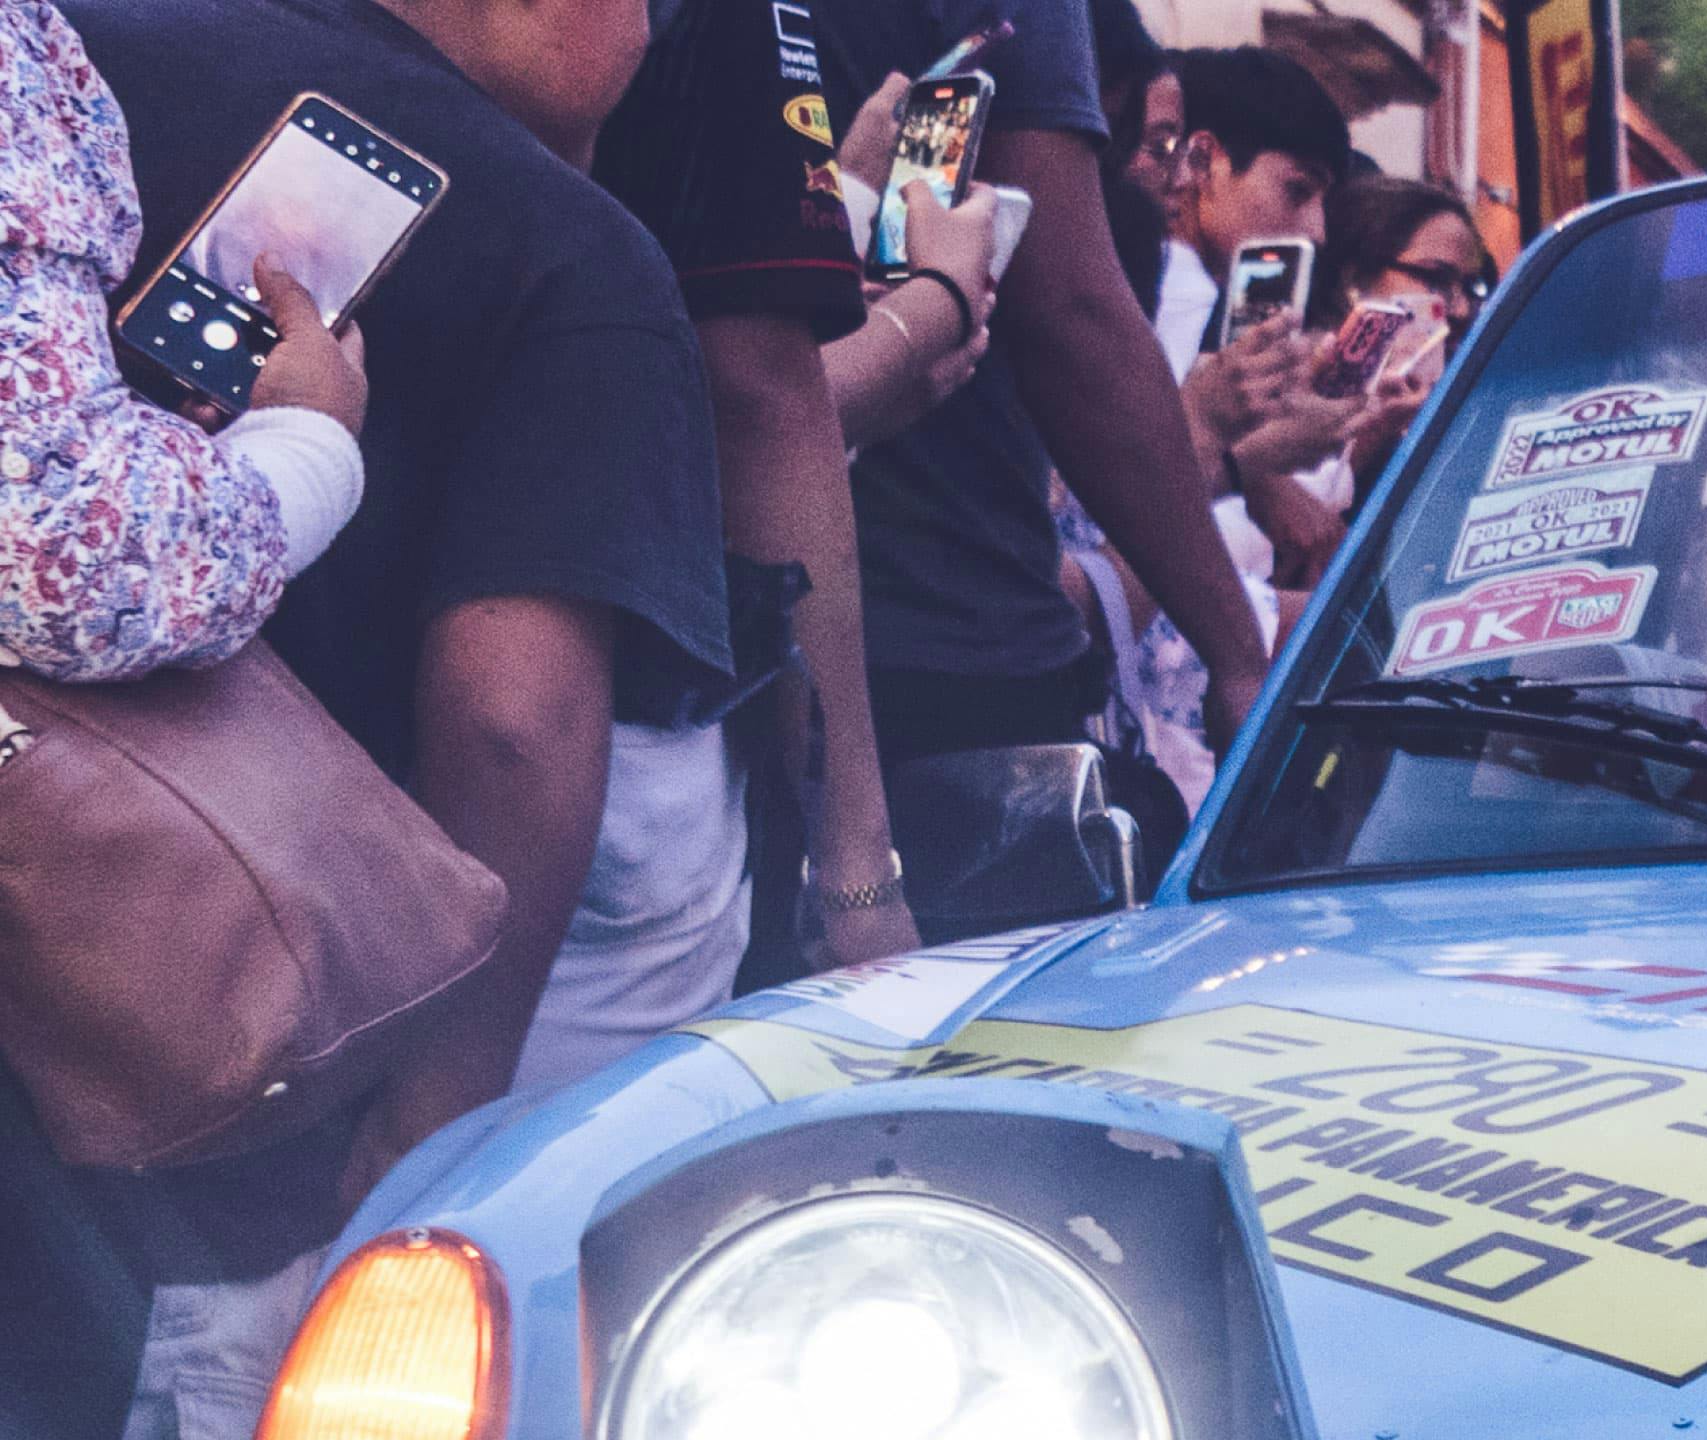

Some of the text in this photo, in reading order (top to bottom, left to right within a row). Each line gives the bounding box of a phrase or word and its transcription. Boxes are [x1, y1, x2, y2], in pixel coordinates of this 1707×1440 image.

[1572, 394, 1641, 423] OK
[1536, 417, 1654, 447] Approved
[1529, 431, 1678, 473] MOTUL
[1531, 510, 1568, 530] OK
[1589, 500, 1630, 519] 2021
[1468, 520, 1615, 568] MOTUL
[1408, 604, 1538, 661] OK
